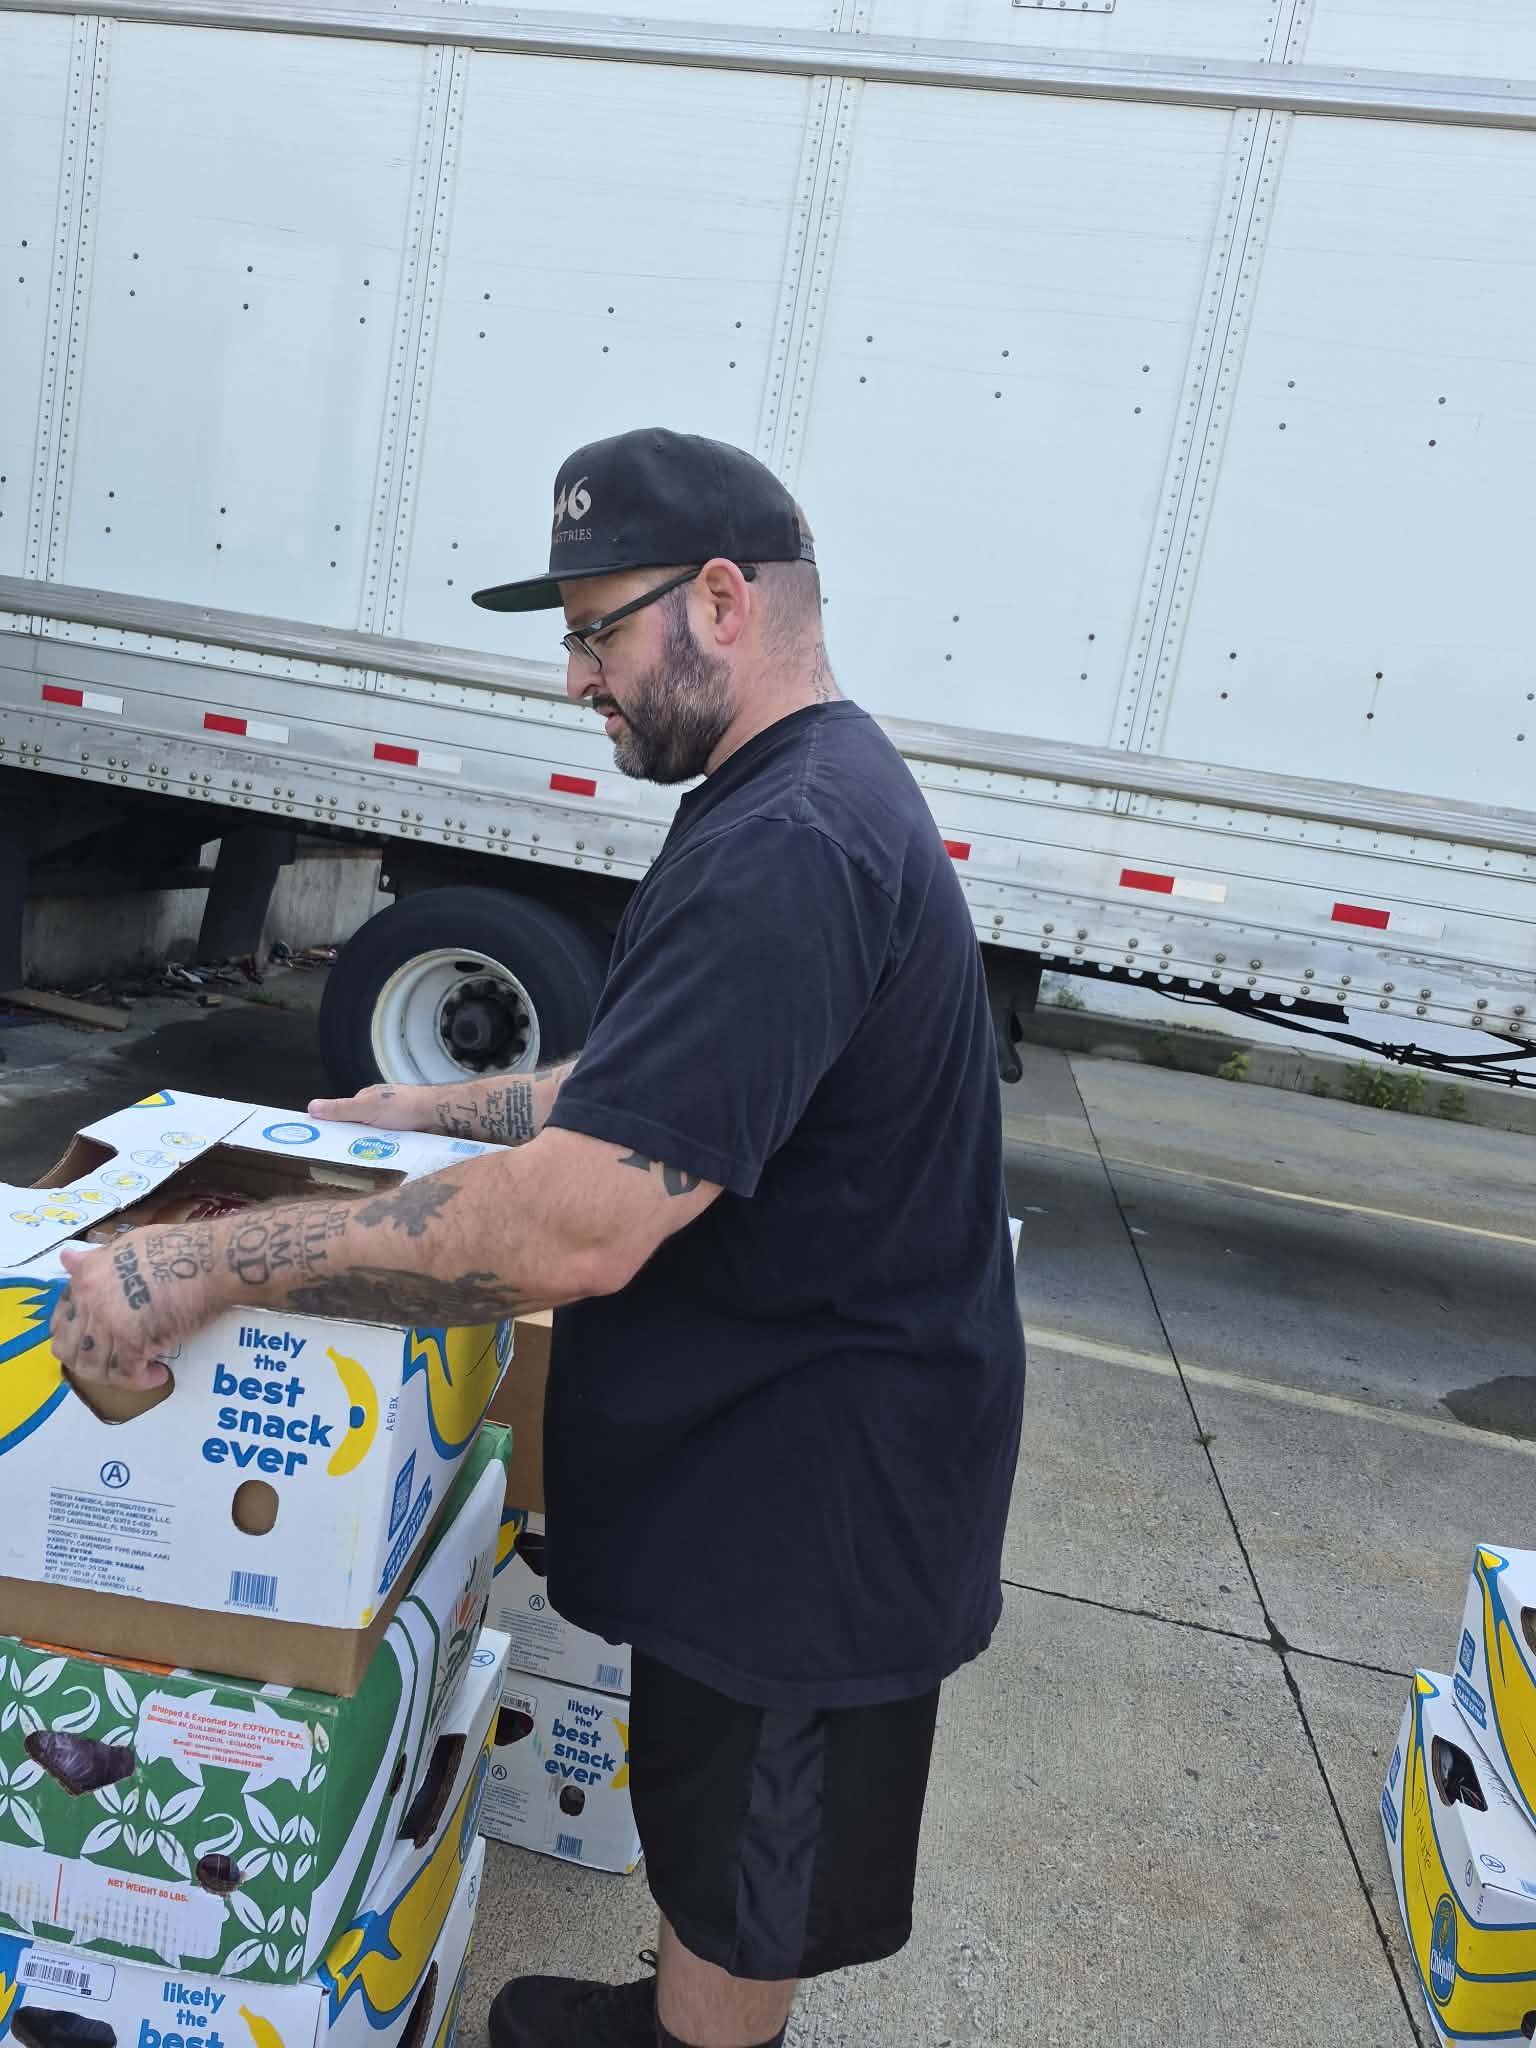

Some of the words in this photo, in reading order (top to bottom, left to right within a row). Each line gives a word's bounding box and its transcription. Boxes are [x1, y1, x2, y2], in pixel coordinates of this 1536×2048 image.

[239, 1326, 307, 1359] likely
[254, 1353, 287, 1372] the
[213, 1363, 305, 1408] best
[217, 1406, 334, 1447] snack
[202, 1437, 308, 1476] ever
[49, 1500, 79, 1510] CHIQUITA
[48, 1515, 68, 1524] FORT
[80, 1533, 111, 1543] BANANAS
[46, 1551, 77, 1560] COUNTRY
[115, 1561, 144, 1571] PANAMA
[70, 1547, 93, 1555] EXTRA
[567, 1699, 604, 1720] likely
[151, 1704, 183, 1721] Shipped
[184, 1710, 191, 1719] &
[191, 1713, 227, 1728] Exported
[228, 1720, 241, 1731] by:
[242, 1722, 286, 1738] EXFRUTEC
[287, 1731, 304, 1741] S.A.
[552, 1718, 602, 1748] best
[575, 1716, 592, 1728] the
[189, 1723, 227, 1736] GUILLERMO
[262, 1736, 286, 1747] FELIPE
[229, 1738, 262, 1750] ECUADOR
[554, 1742, 616, 1772] snack
[544, 1759, 602, 1785] ever
[107, 1877, 124, 1889] NET
[125, 1881, 158, 1896] WEIGHT
[1431, 1949, 1455, 1985] Chiquita
[163, 1981, 226, 2014] likely
[176, 2009, 208, 2028] the
[138, 2018, 224, 2048] best
